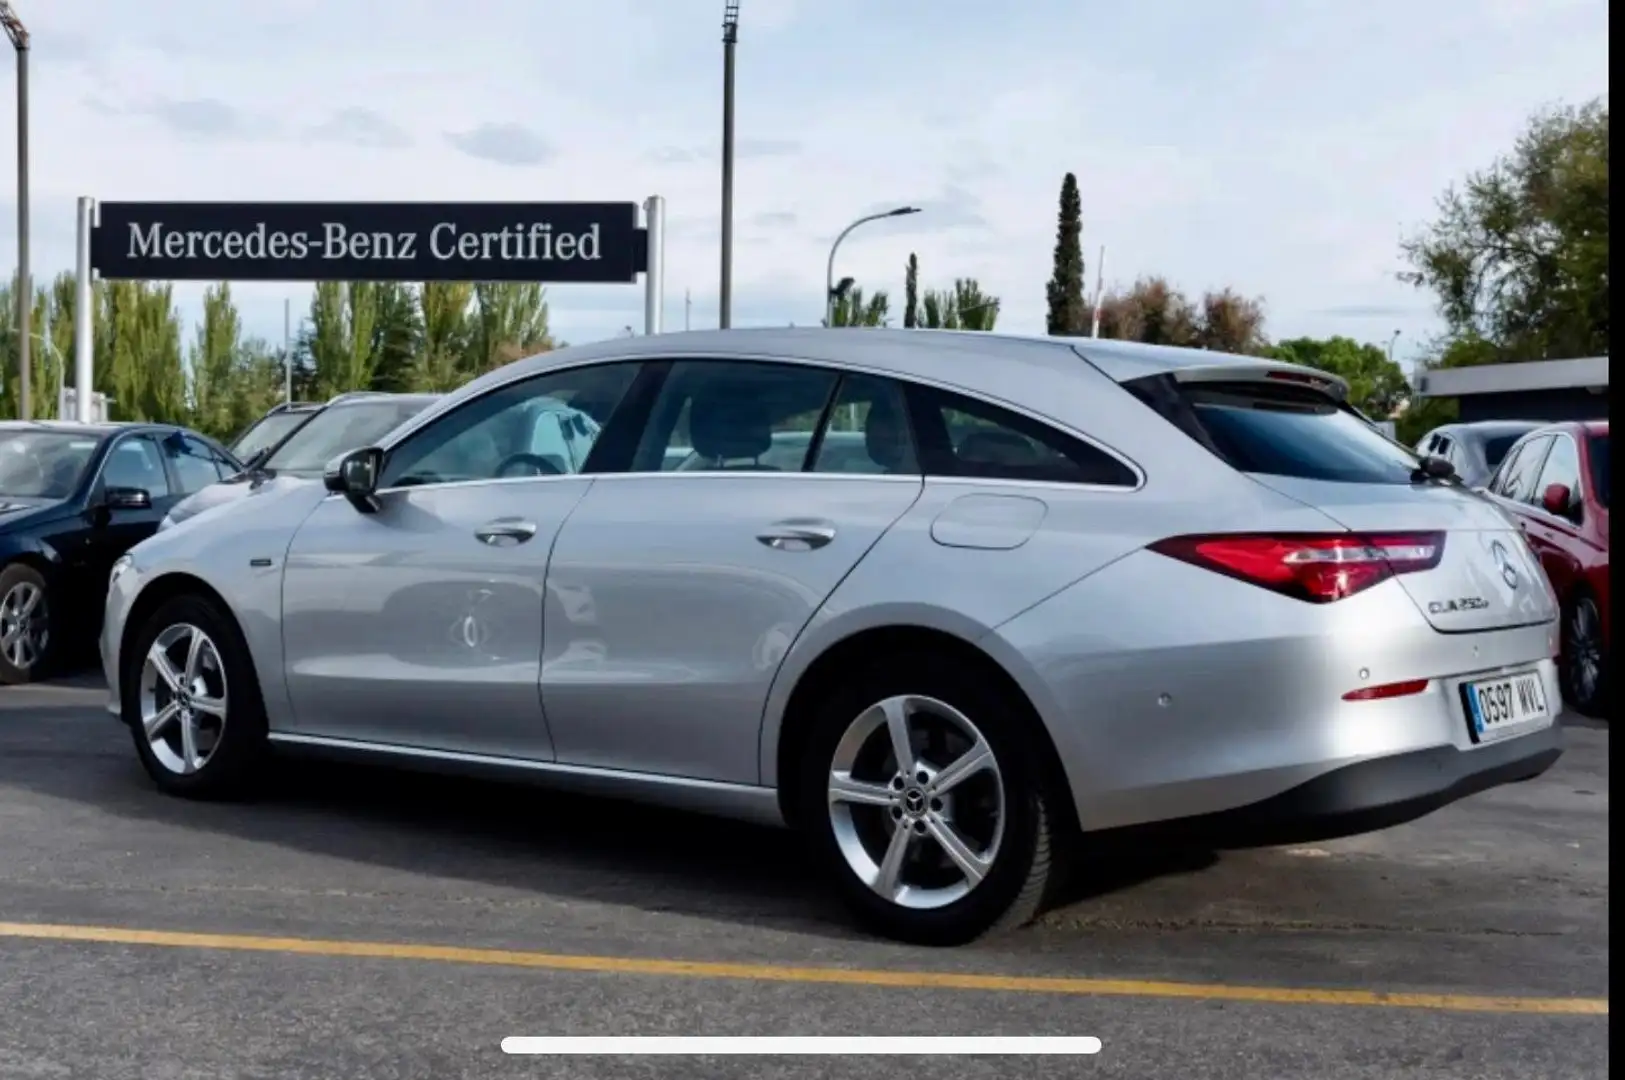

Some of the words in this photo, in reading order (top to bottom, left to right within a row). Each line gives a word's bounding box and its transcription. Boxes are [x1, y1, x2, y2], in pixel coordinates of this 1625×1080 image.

[125, 221, 417, 260] Mercedes-Benz
[430, 221, 602, 261] Certified
[1478, 682, 1514, 724] 0597
